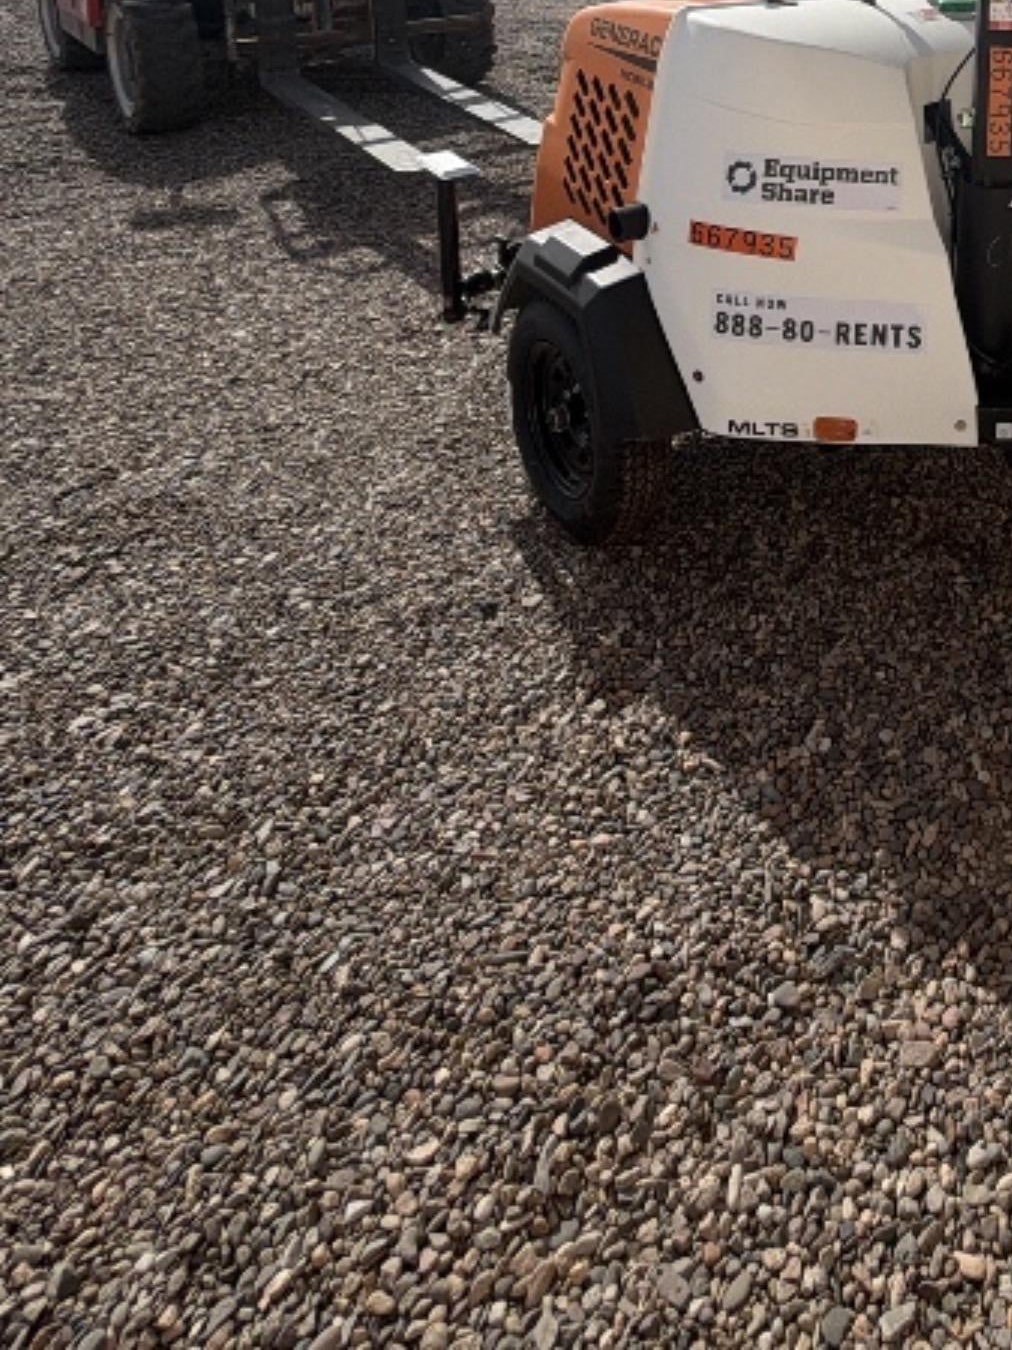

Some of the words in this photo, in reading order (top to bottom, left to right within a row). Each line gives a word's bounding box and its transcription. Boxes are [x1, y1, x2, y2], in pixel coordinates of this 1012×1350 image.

[763, 158, 899, 186] Equipment
[761, 182, 835, 205] Share
[691, 220, 796, 260] 667935
[714, 311, 923, 349] 888-80-RENTS
